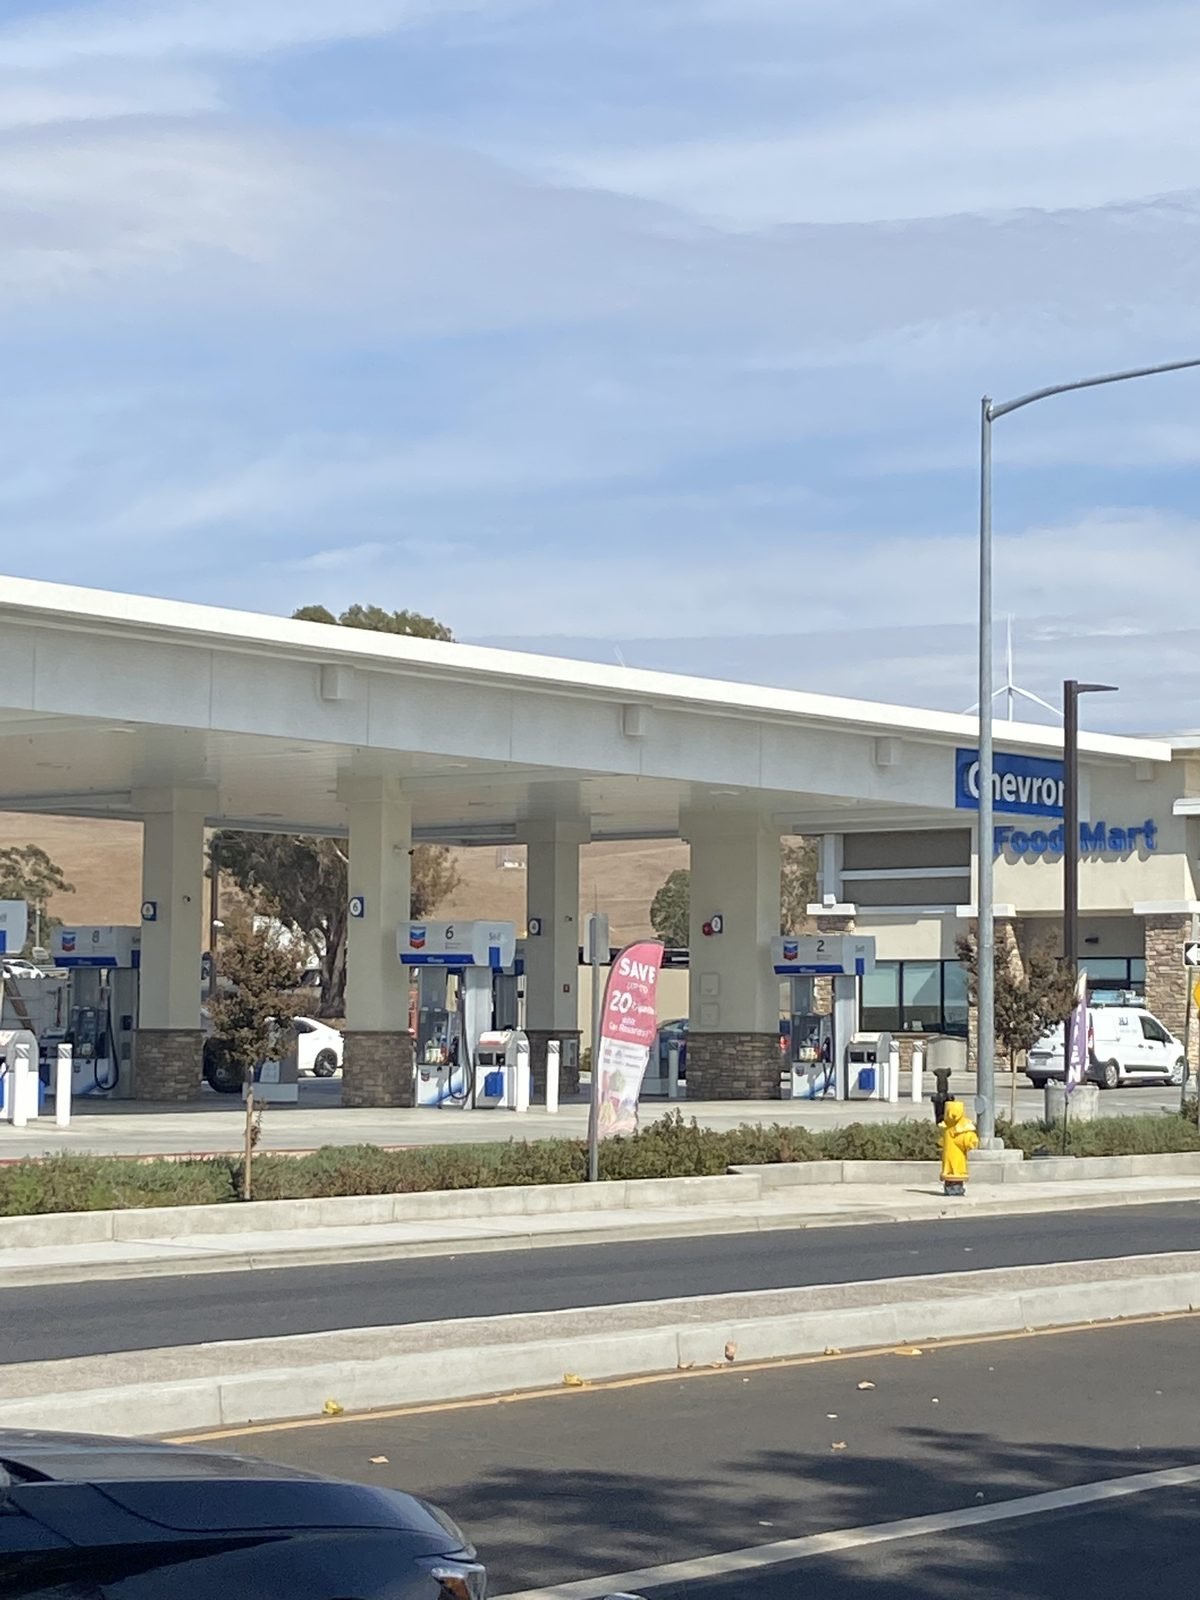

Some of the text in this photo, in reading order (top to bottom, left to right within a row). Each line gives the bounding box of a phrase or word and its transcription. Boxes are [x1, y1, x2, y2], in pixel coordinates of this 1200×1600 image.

[993, 818, 1158, 854] Food Mart
[445, 925, 454, 940] 6
[816, 939, 825, 952] 2
[618, 957, 656, 985] SAVE
[609, 990, 632, 1013] 20
